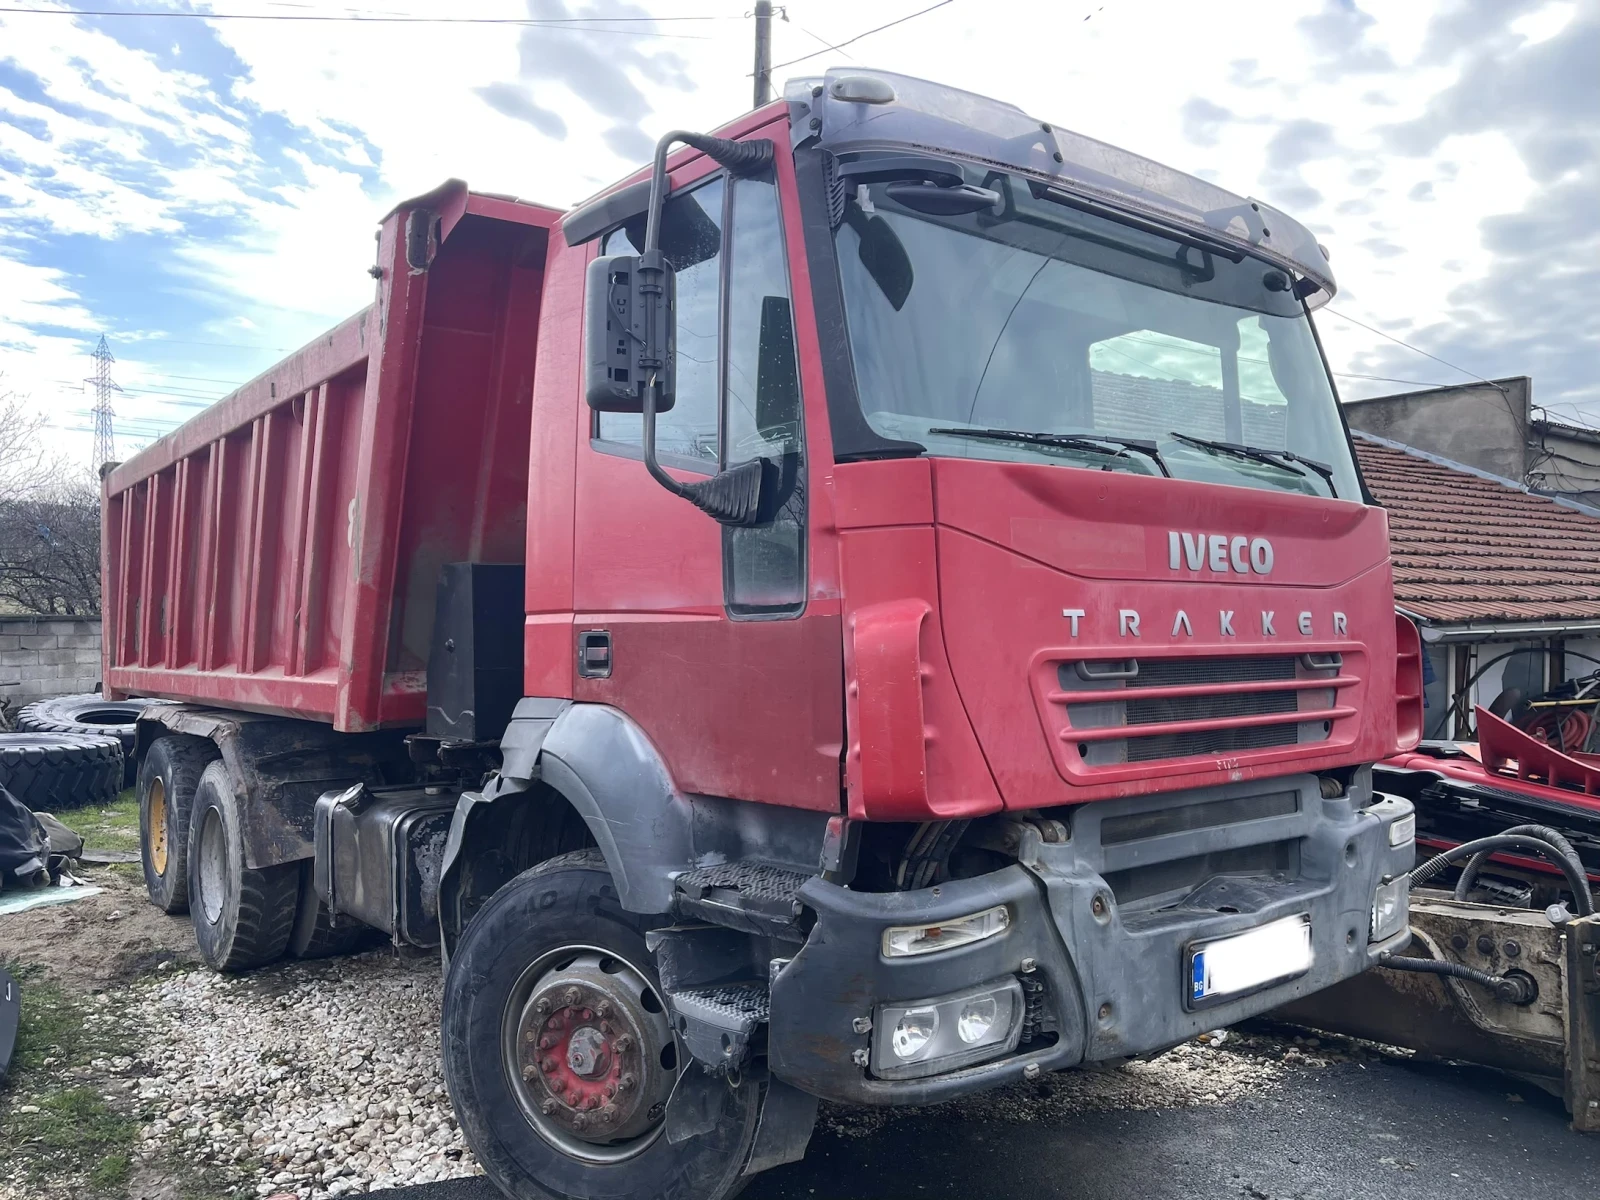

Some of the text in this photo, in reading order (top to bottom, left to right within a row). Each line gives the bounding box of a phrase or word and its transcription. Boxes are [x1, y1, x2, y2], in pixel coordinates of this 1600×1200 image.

[1168, 531, 1274, 575] IVECO
[1062, 608, 1348, 637] TRAKKER
[1194, 980, 1204, 992] BG
